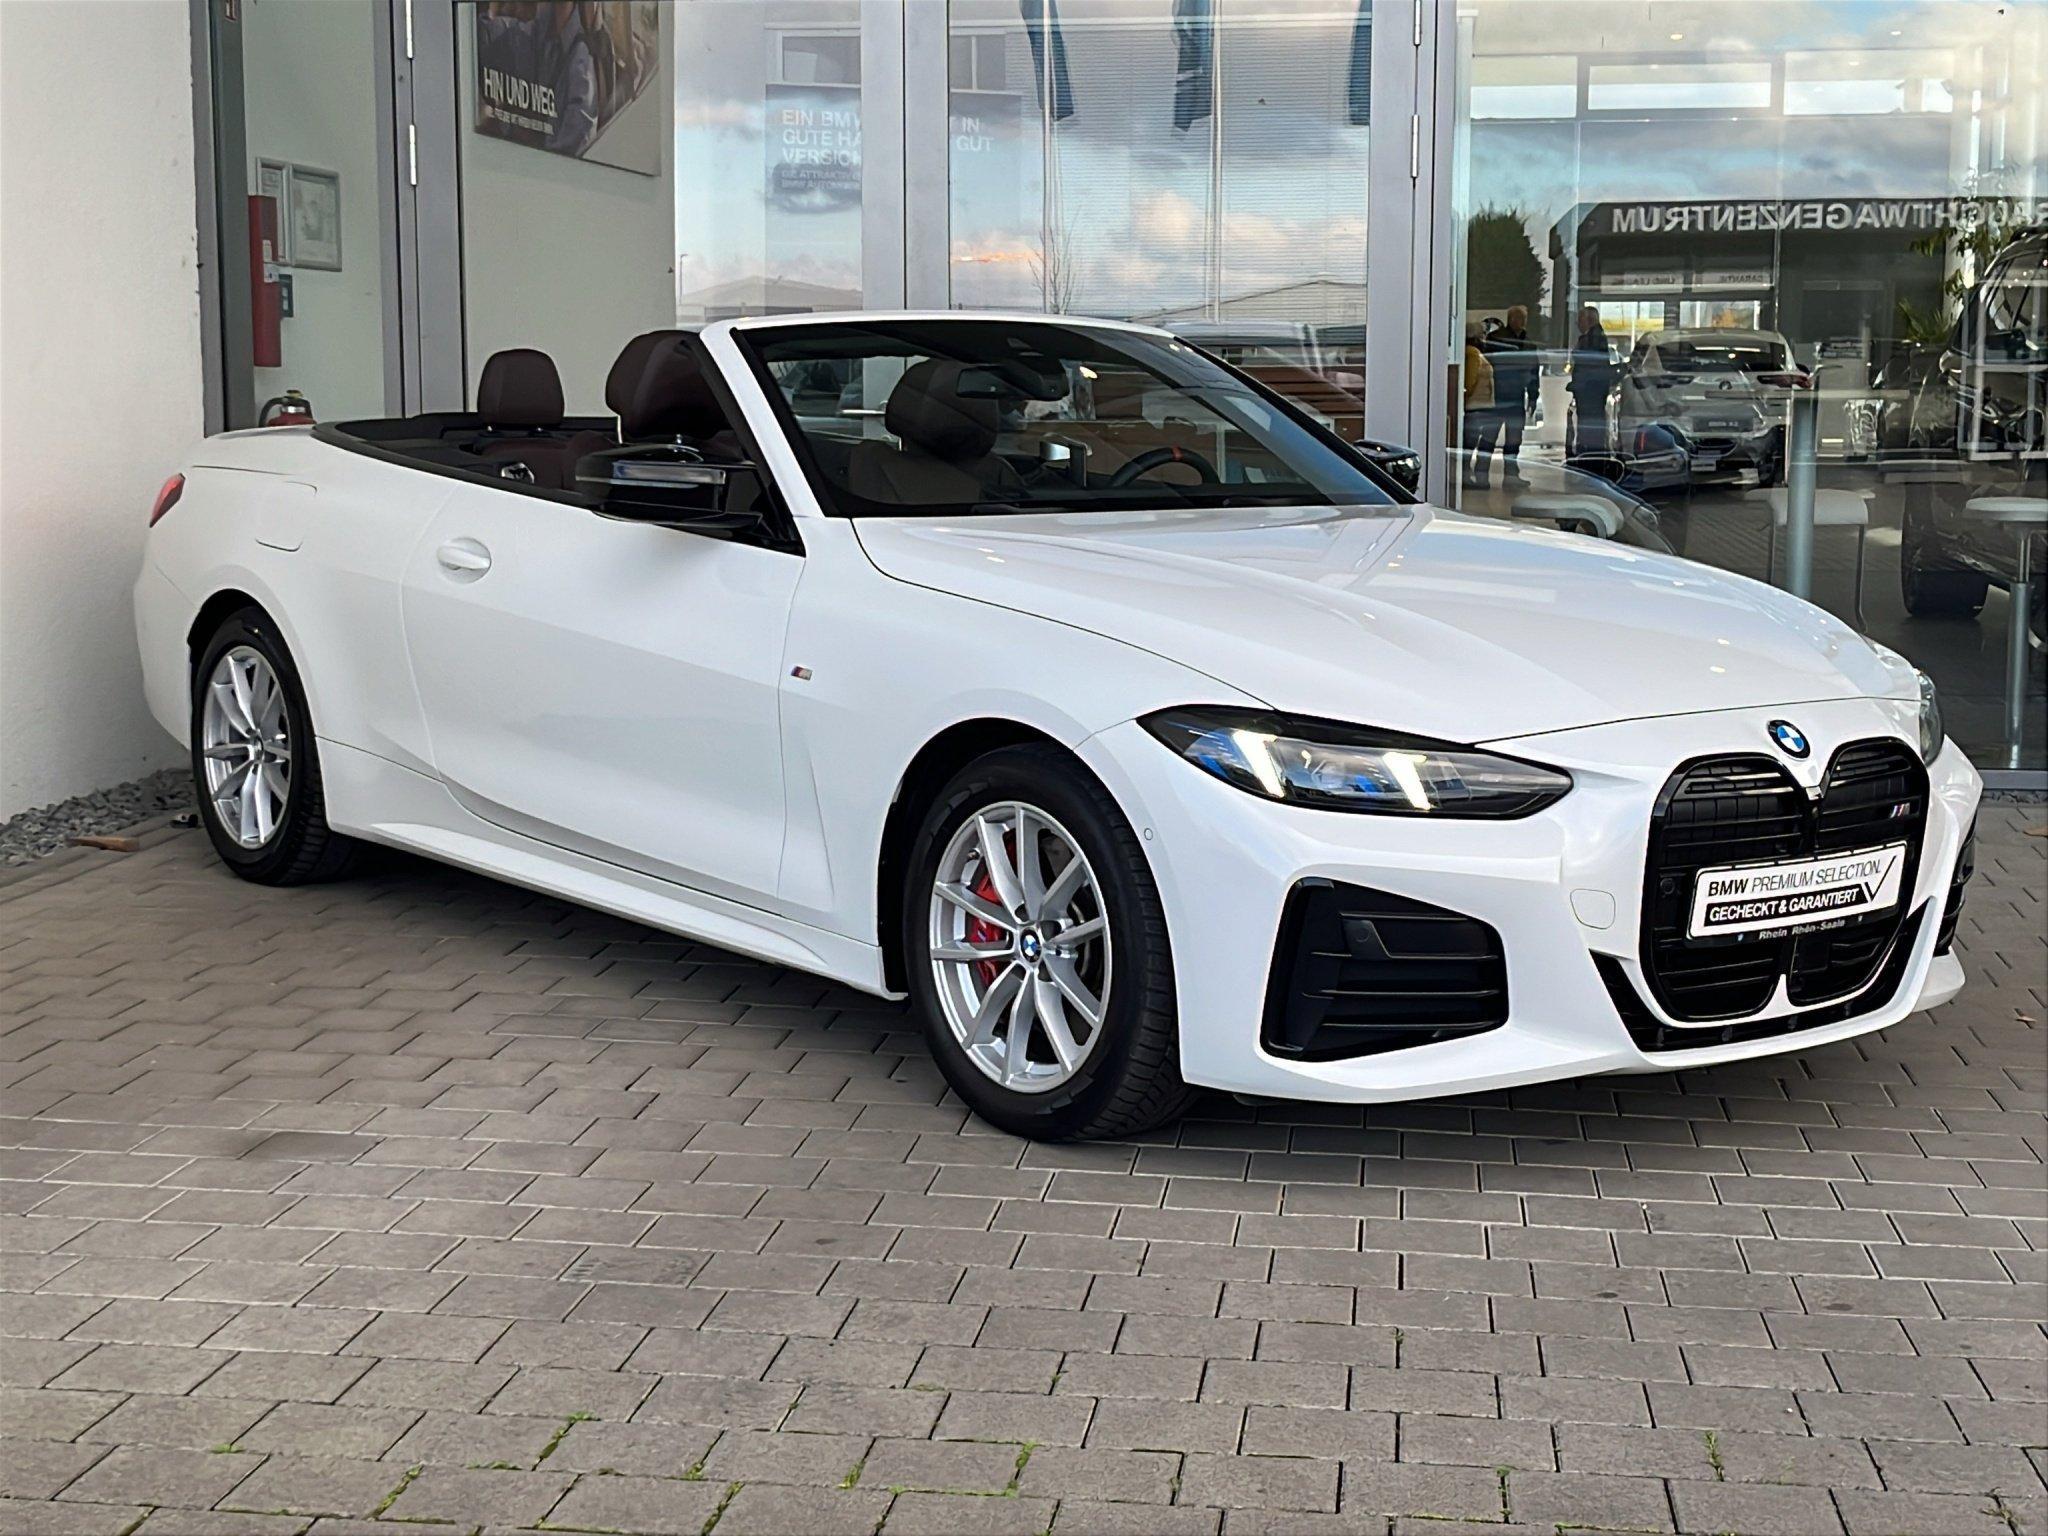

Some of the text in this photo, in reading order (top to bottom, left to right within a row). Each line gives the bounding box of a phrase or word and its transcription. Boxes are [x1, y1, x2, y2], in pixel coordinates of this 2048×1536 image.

[484, 66, 504, 103] HIN
[506, 73, 530, 110] UND
[782, 109, 813, 126] EIN
[962, 116, 980, 133] IN
[783, 129, 833, 146] GUTE
[956, 135, 994, 152] GUT
[1708, 878, 1749, 897] BMW
[1751, 870, 1815, 893] PREMIUM
[1709, 888, 1860, 922] GECHECKT & GARANTIERT
[1758, 929, 1788, 941] Rhein
